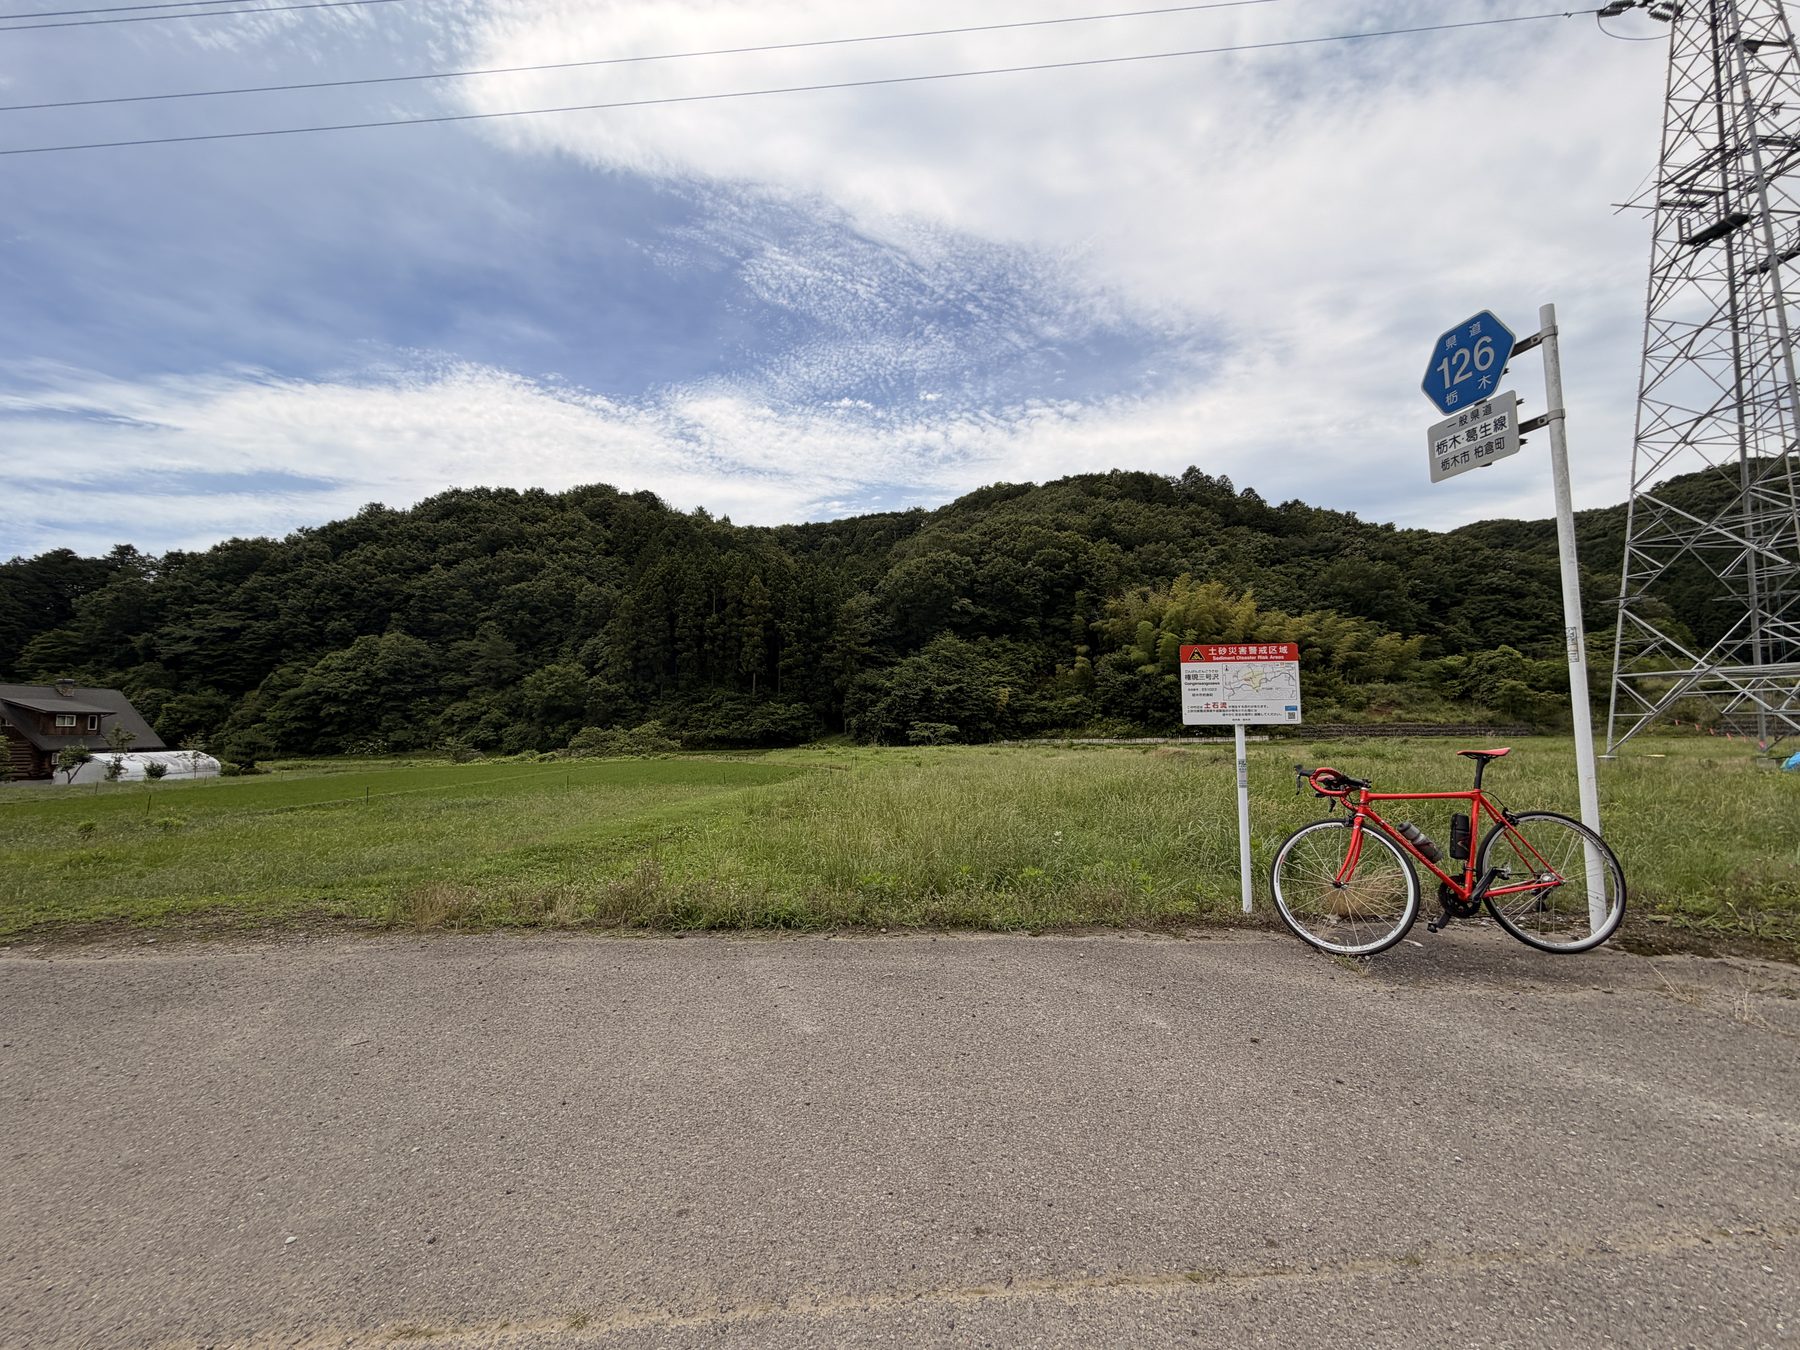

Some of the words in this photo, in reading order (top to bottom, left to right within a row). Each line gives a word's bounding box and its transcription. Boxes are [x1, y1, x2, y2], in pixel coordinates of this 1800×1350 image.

[1445, 321, 1482, 351] 県道
[1436, 335, 1495, 390] 126
[1446, 403, 1493, 429] 一般県道
[1440, 450, 1470, 472] 栃木市
[1474, 436, 1505, 459] 柏倉町
[1208, 646, 1288, 655] 土砂災害警戒区域
